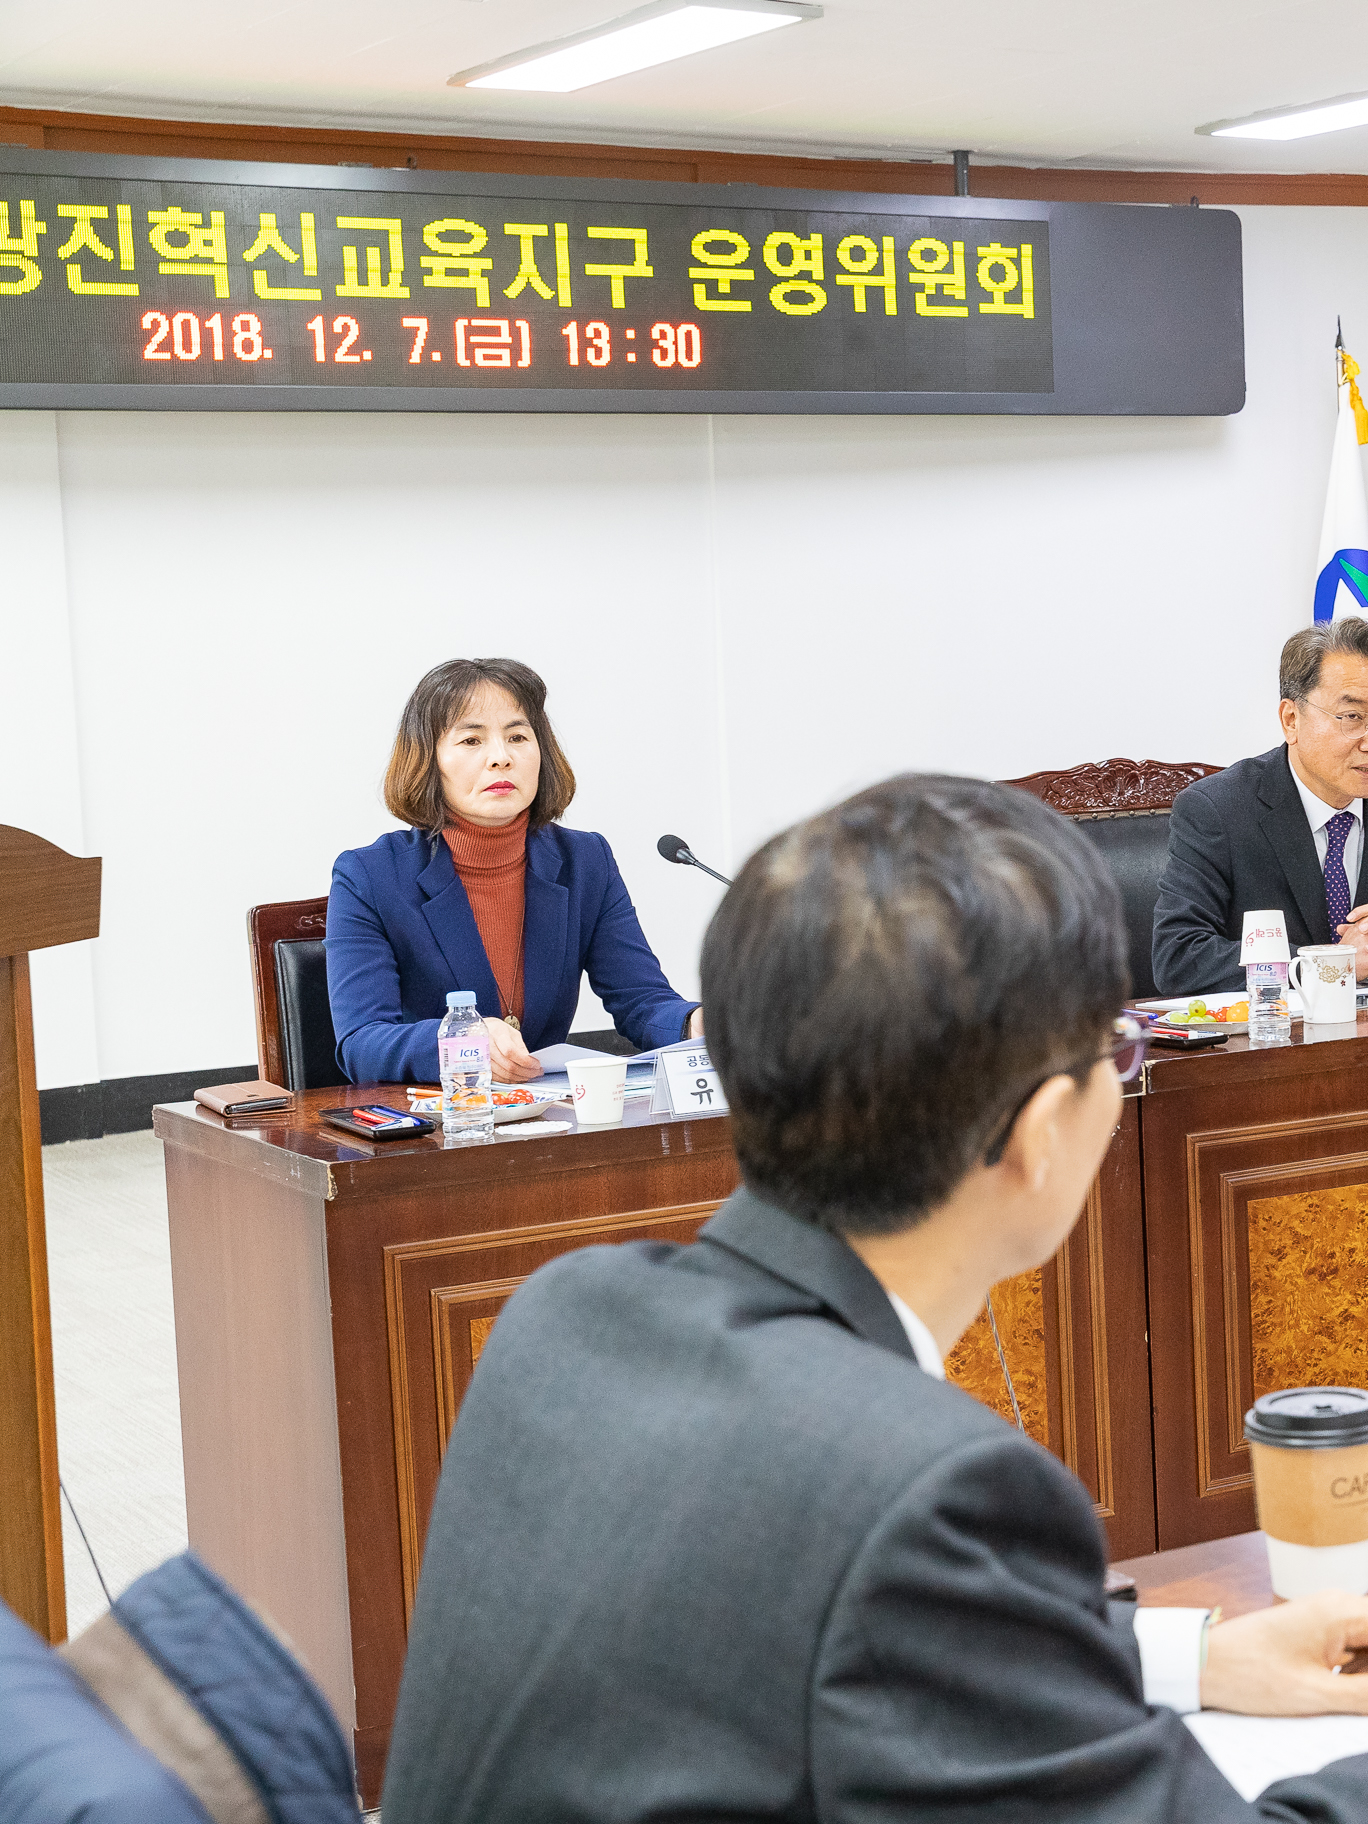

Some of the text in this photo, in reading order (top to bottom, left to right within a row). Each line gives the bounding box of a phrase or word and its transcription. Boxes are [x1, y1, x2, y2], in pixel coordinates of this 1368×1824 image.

[689, 229, 1035, 319] 운영위원회
[140, 310, 274, 362] 2018.
[306, 314, 373, 364] 12.
[690, 1078, 714, 1106] 유
